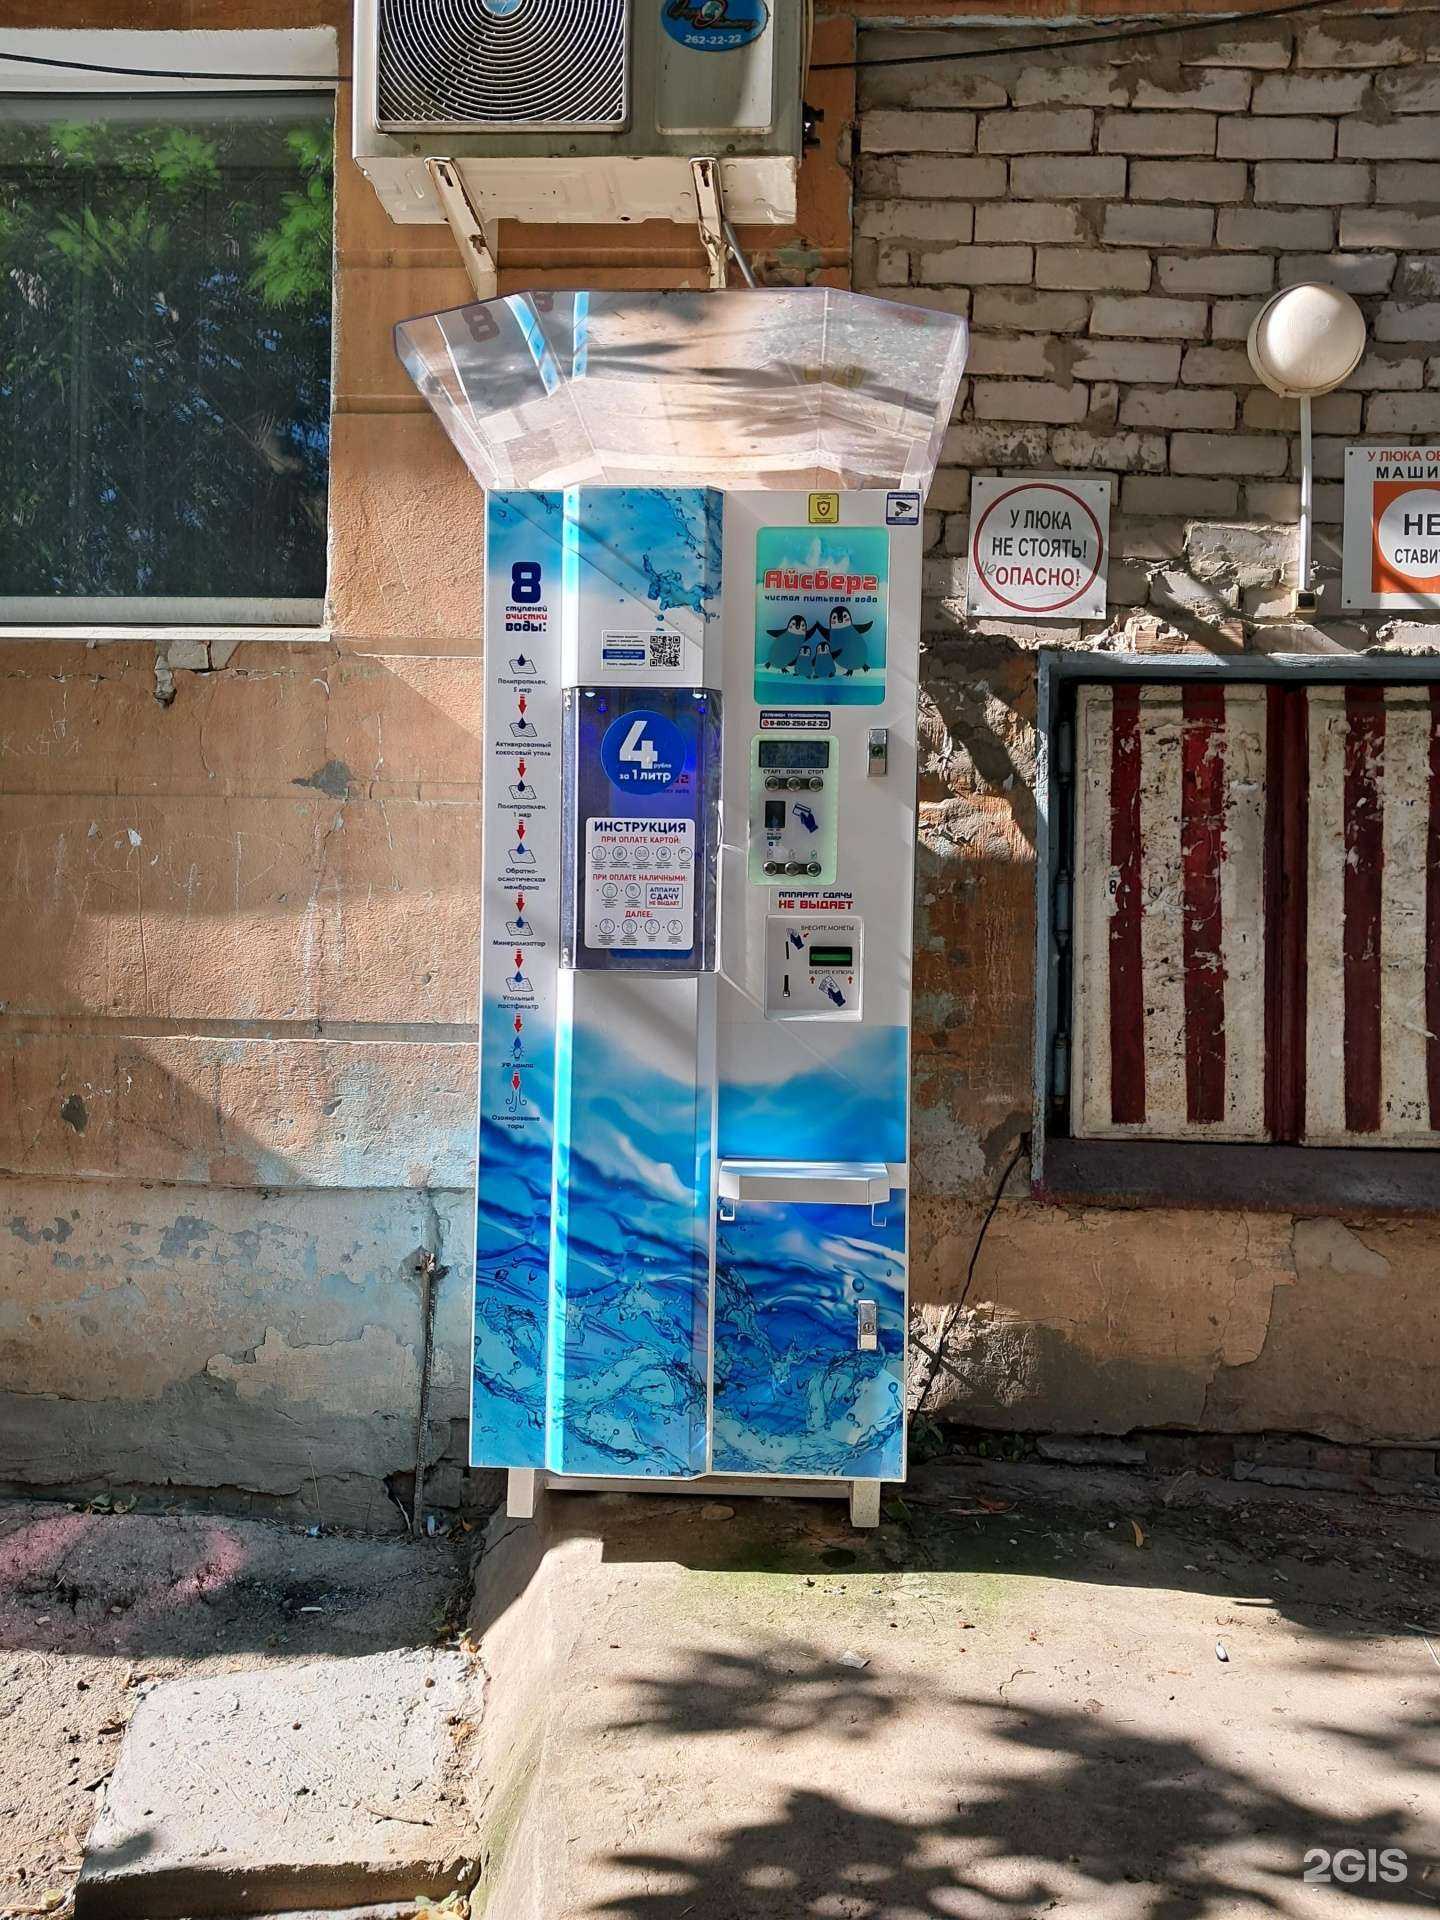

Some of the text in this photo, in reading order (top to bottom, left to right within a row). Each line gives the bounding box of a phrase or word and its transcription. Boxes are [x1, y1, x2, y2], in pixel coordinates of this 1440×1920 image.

[684, 34, 741, 45] 262-22-22
[1368, 451, 1376, 462] У
[1379, 450, 1422, 462] ЛЮКА
[1010, 509, 1072, 530] У ЛЮКА
[1404, 513, 1440, 536] НЕ
[992, 537, 1087, 558] НЕ СТОЯТЬ!
[511, 562, 541, 603] 8
[764, 568, 879, 595] Айсберг
[995, 566, 1081, 587] ОПАСНО!
[505, 604, 547, 613] ступеней
[505, 621, 547, 632] воды:
[619, 720, 658, 769] 4
[632, 769, 638, 780] 1
[640, 772, 672, 783] литр
[594, 821, 687, 834] ИНСТРУКЦИЯ
[650, 893, 679, 901] СДАЧУ
[778, 900, 853, 909] НЕ ВЫДАЕТ
